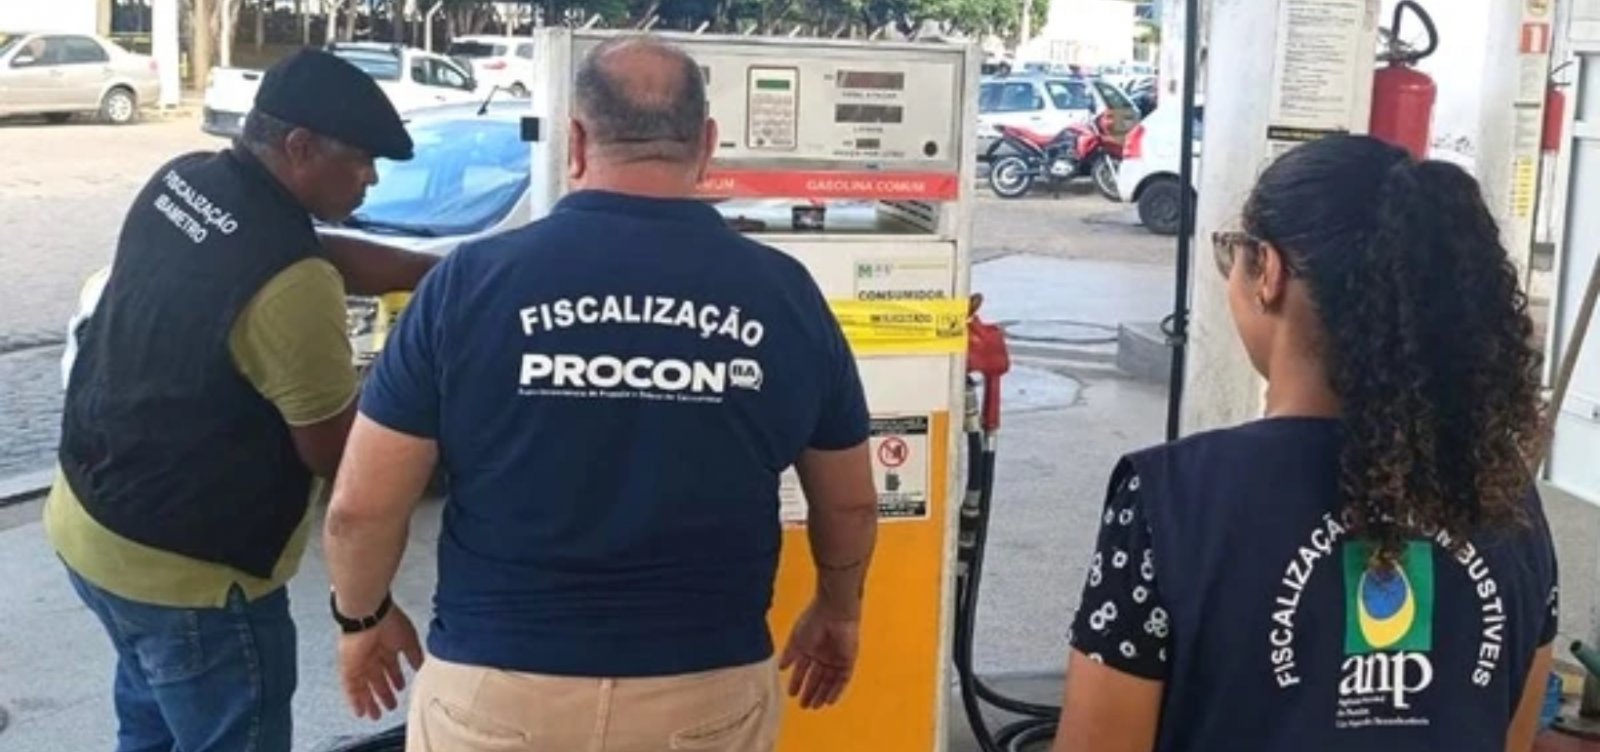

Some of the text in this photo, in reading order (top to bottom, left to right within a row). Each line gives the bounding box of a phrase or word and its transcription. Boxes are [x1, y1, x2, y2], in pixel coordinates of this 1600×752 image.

[162, 170, 239, 234] FISCALIZAÇÃO
[806, 179, 926, 193] GASOLINA COMUM
[153, 193, 208, 243] IBAMETRO
[519, 295, 764, 348] FISCALIZAÇÃO
[519, 353, 726, 393] PROCON
[1338, 650, 1434, 709] anp
